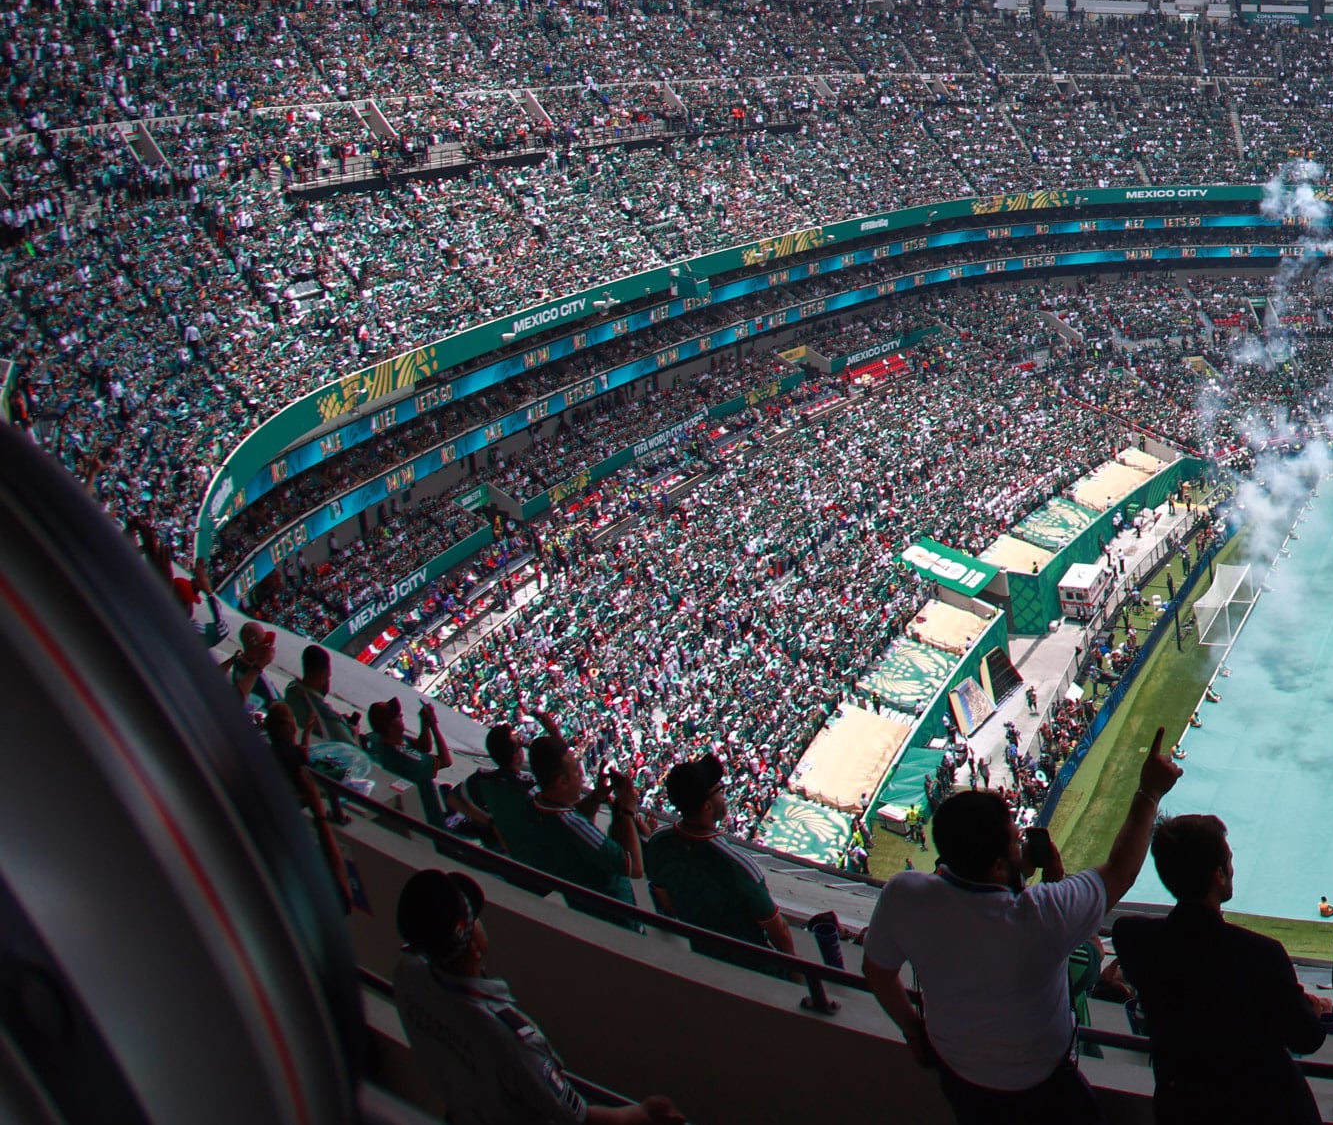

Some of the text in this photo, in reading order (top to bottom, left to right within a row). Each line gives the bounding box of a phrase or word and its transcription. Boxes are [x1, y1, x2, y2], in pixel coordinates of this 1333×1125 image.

[1126, 188, 1208, 199] MEXICO CITY
[1189, 217, 1200, 227] GO
[917, 238, 926, 248] GO
[1045, 256, 1055, 266] GO
[817, 301, 825, 312] GO
[513, 298, 586, 333] MEXICO CITY
[847, 339, 901, 366] MEXICO CITY
[633, 442, 649, 457] FIFA
[648, 430, 671, 449] WORLD
[348, 569, 428, 635] MEXICO CITY
